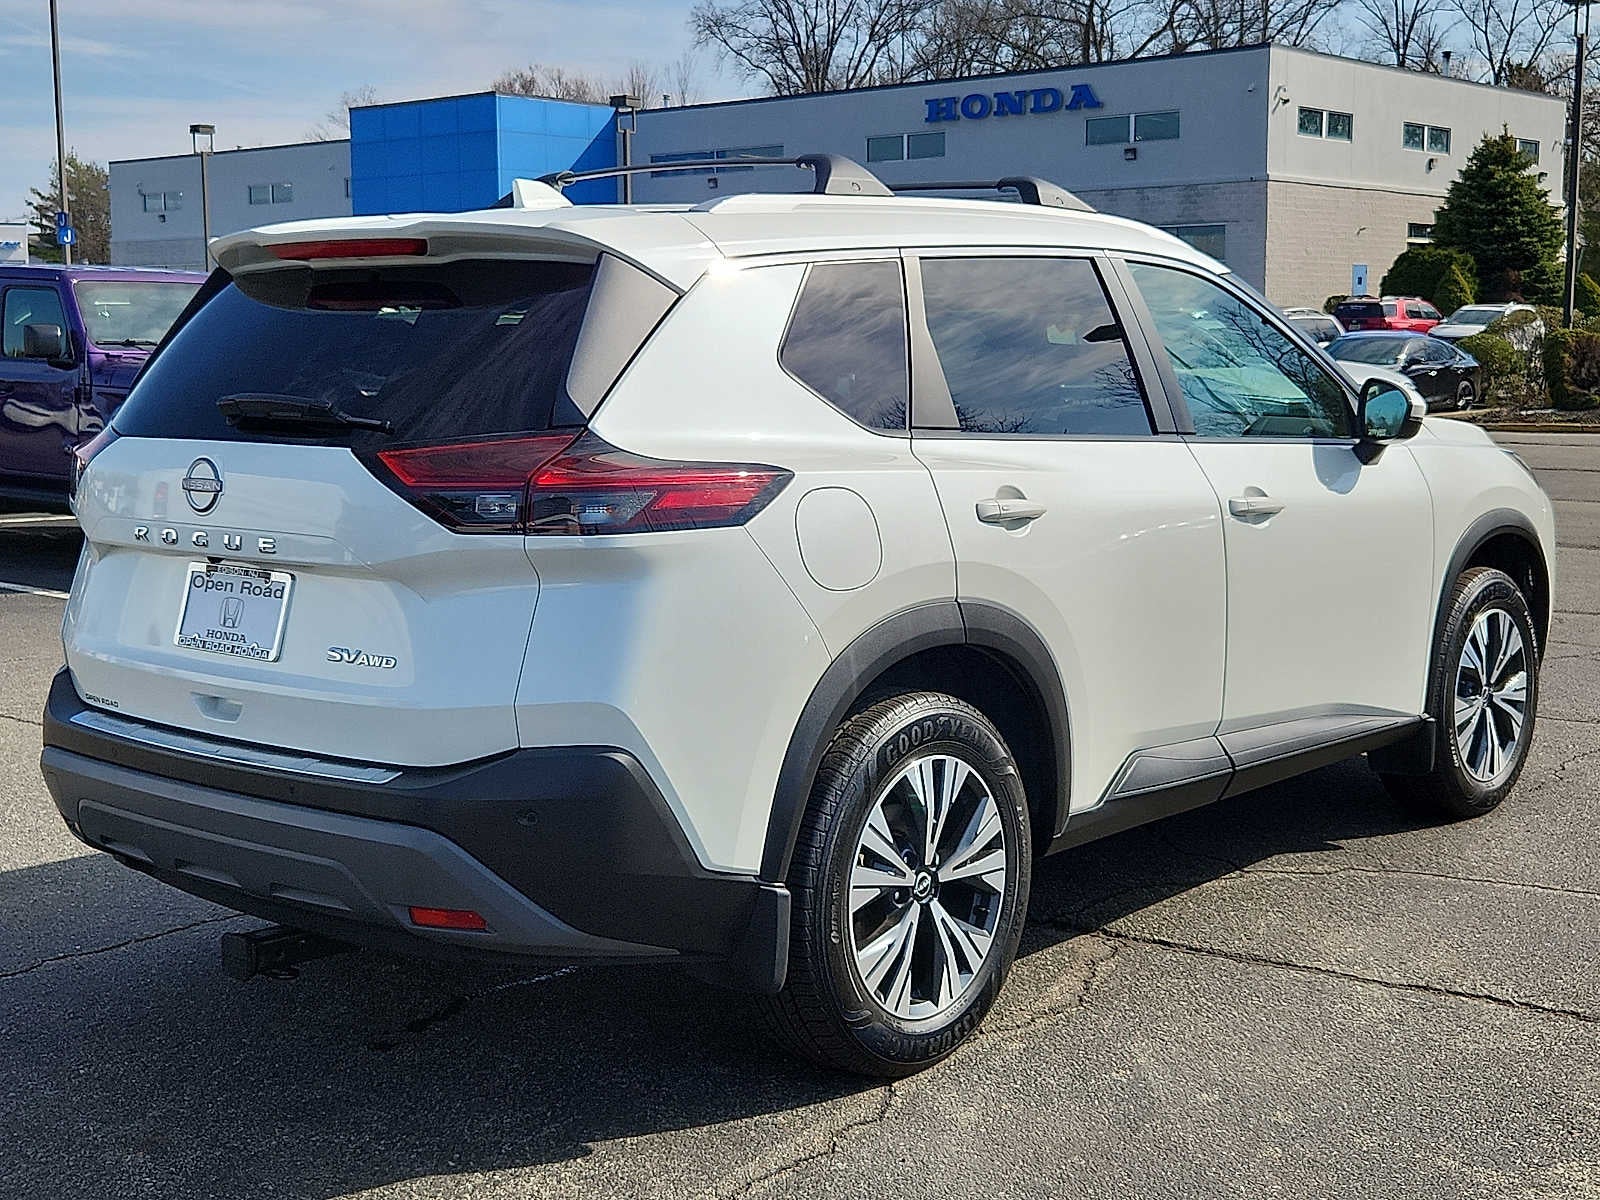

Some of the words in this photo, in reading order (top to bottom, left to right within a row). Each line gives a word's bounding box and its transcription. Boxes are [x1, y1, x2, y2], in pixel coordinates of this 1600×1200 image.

[924, 83, 1104, 124] HONDA
[63, 229, 72, 243] J
[182, 478, 222, 492] NISSAN
[134, 525, 277, 554] ROGUE
[192, 574, 234, 592] Open
[239, 580, 286, 599] Road
[179, 637, 205, 648] OPEN
[205, 641, 234, 653] ROAD
[233, 645, 269, 658] HONDA
[206, 629, 247, 643] HONDA
[885, 716, 998, 766] GOODYEAR
